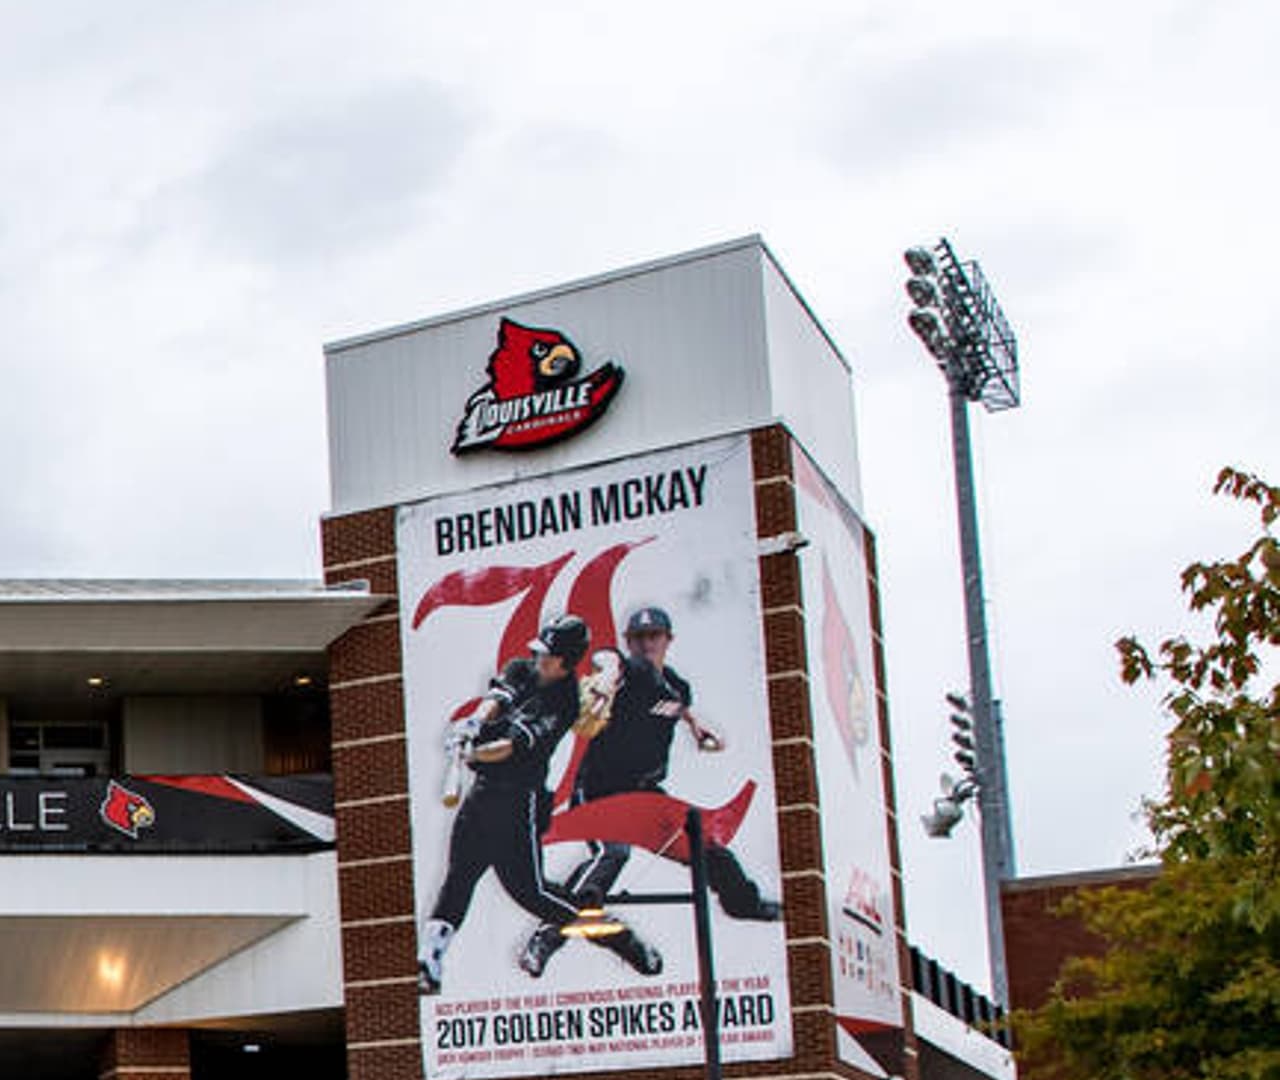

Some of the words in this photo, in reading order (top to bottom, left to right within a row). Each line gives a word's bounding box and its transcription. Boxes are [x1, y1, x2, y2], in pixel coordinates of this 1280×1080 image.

[459, 382, 592, 447] LOUISVILLE
[434, 490, 582, 557] BRENDAN
[589, 464, 707, 527] MCKAY
[436, 1016, 487, 1049] 2017
[493, 1009, 583, 1046] GOLDEN
[589, 1001, 676, 1038] SPIKES
